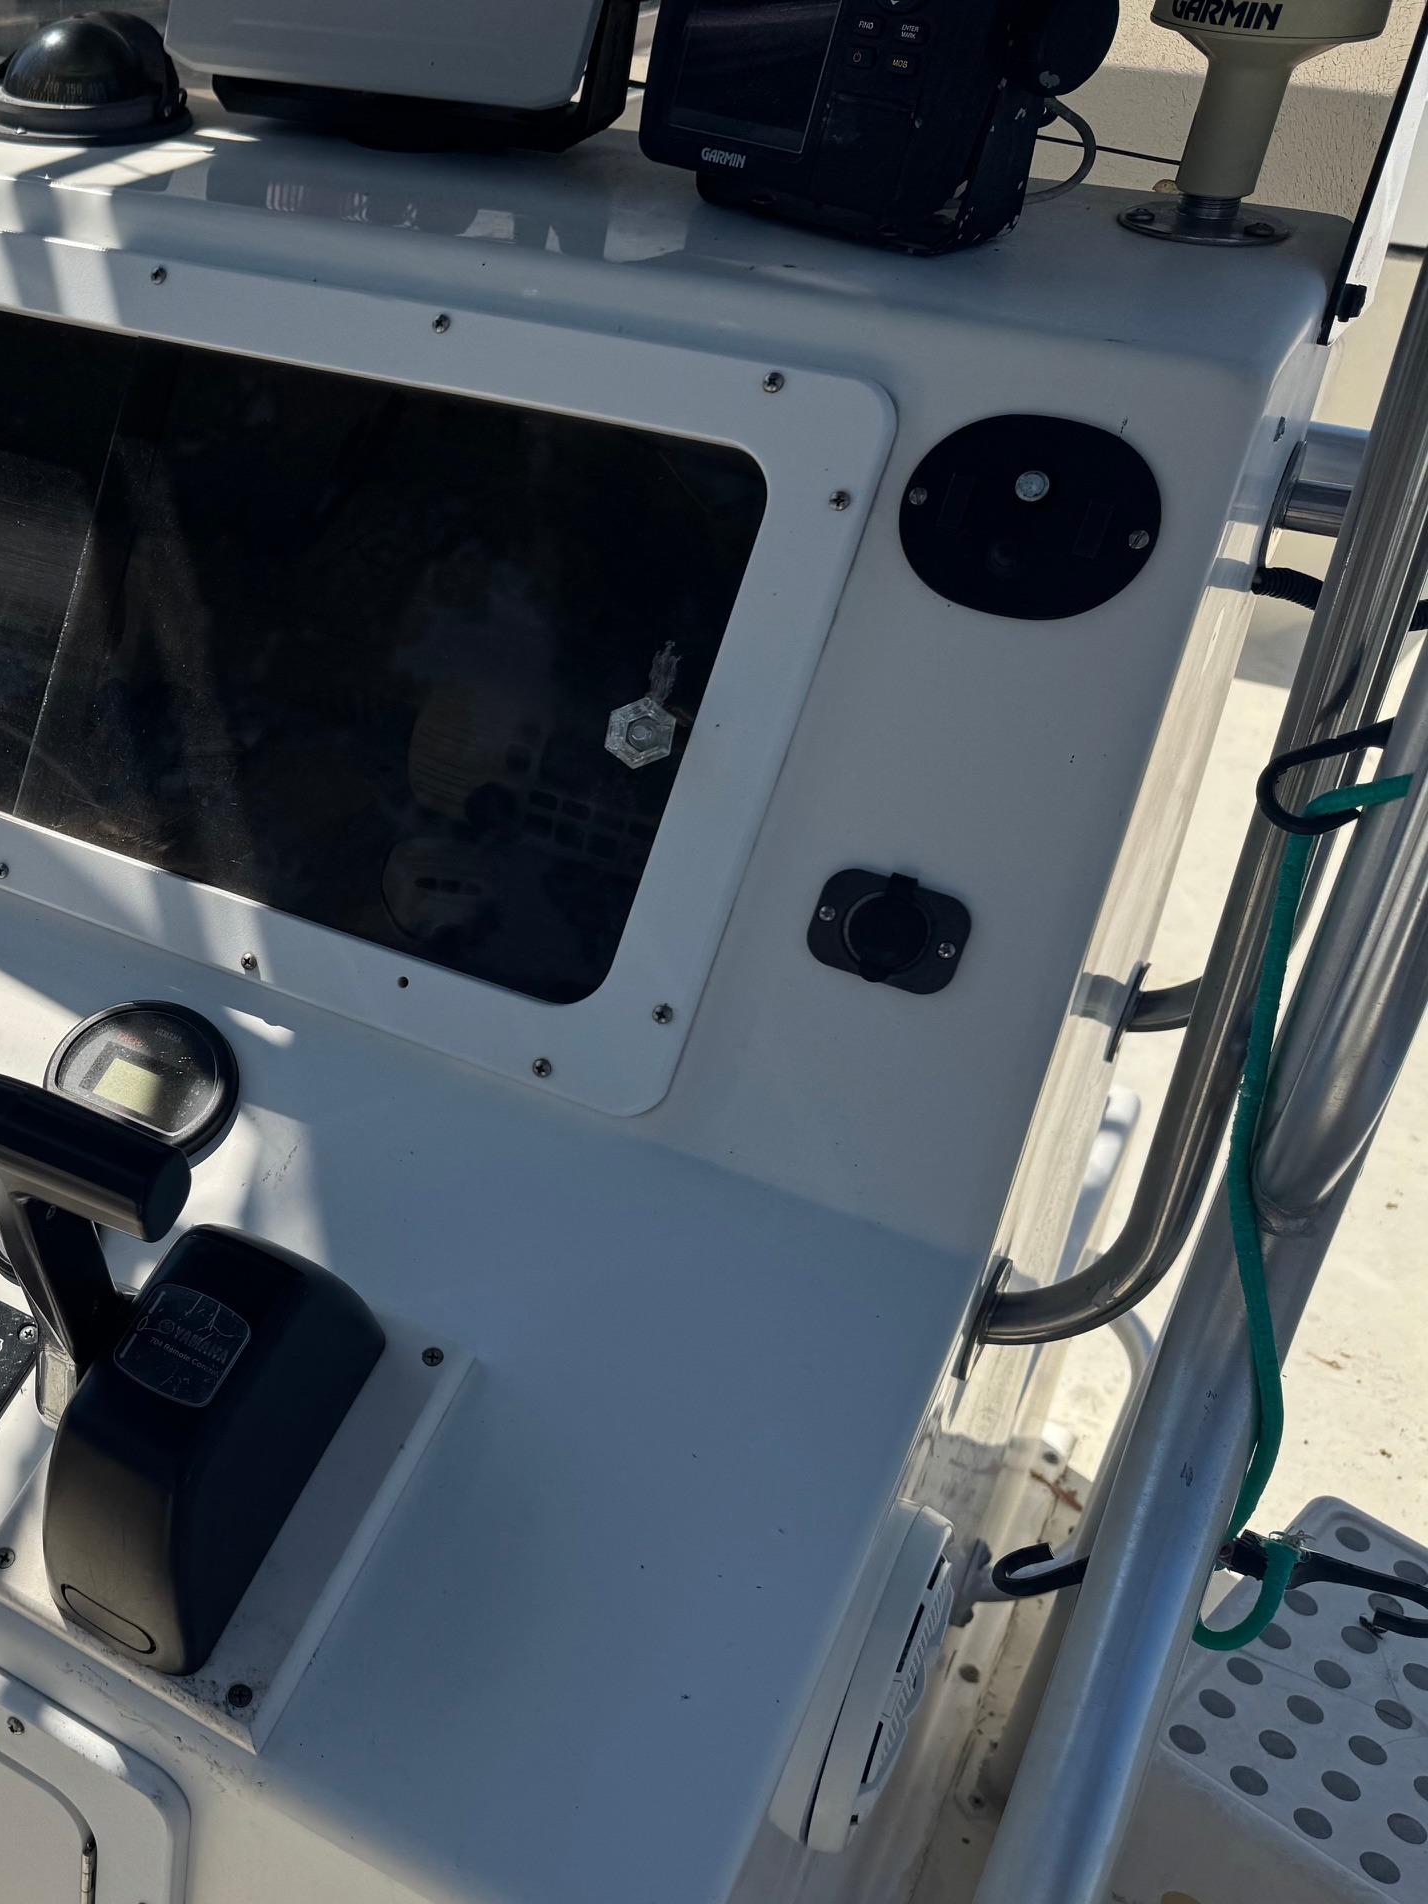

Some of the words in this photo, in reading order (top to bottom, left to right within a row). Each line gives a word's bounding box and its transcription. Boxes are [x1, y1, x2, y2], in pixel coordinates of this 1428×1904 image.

[1171, 0, 1283, 30] GARMIN
[858, 20, 874, 30] FIND
[892, 59, 908, 68] MOB
[701, 146, 746, 168] GARMIN
